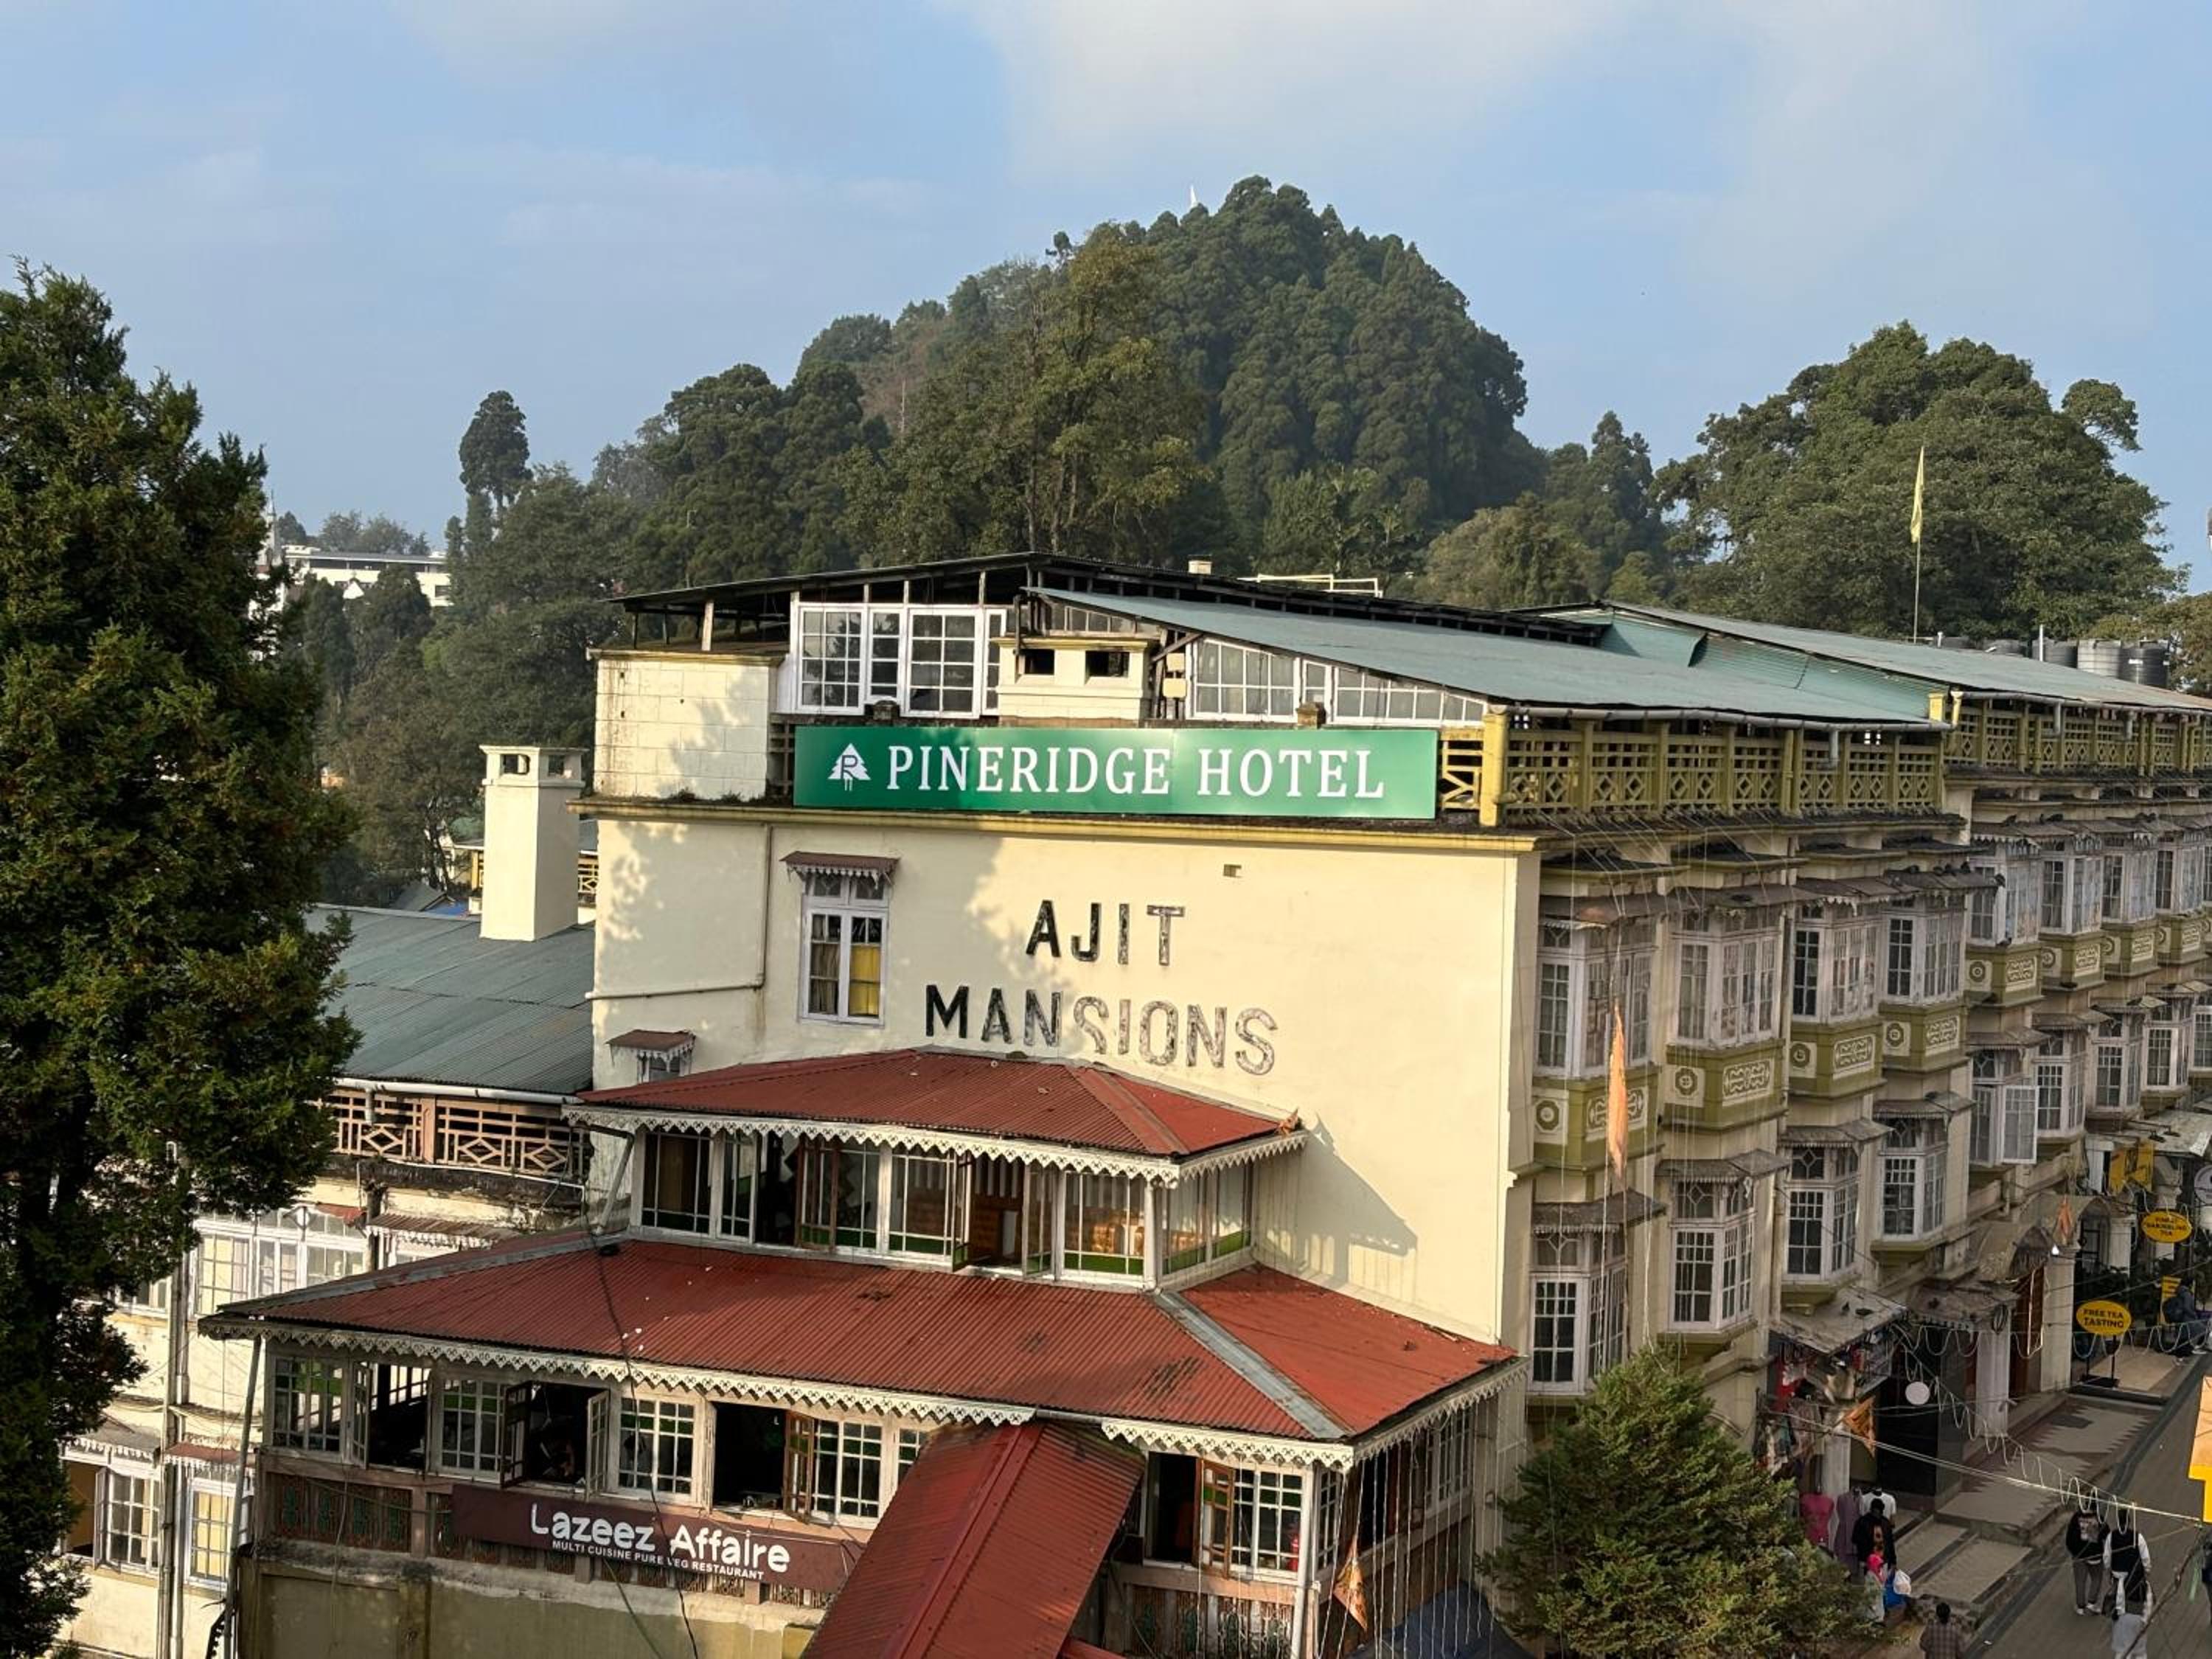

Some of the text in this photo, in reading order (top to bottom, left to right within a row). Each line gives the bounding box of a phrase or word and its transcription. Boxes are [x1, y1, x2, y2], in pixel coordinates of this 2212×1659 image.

[886, 745, 1385, 800] PINERIDGE HOTEL
[1025, 899, 1186, 967] AJIT
[925, 983, 1279, 1077] MANSIONS
[2082, 1308, 2124, 1319] FREE TEA
[2083, 1317, 2125, 1328] TASTING
[530, 1502, 790, 1573] Lazeez Affaire
[552, 1540, 585, 1554] MULTI
[588, 1545, 632, 1560] CUISINE
[634, 1551, 664, 1565] PURE
[692, 1559, 765, 1580] RESTAURANT
